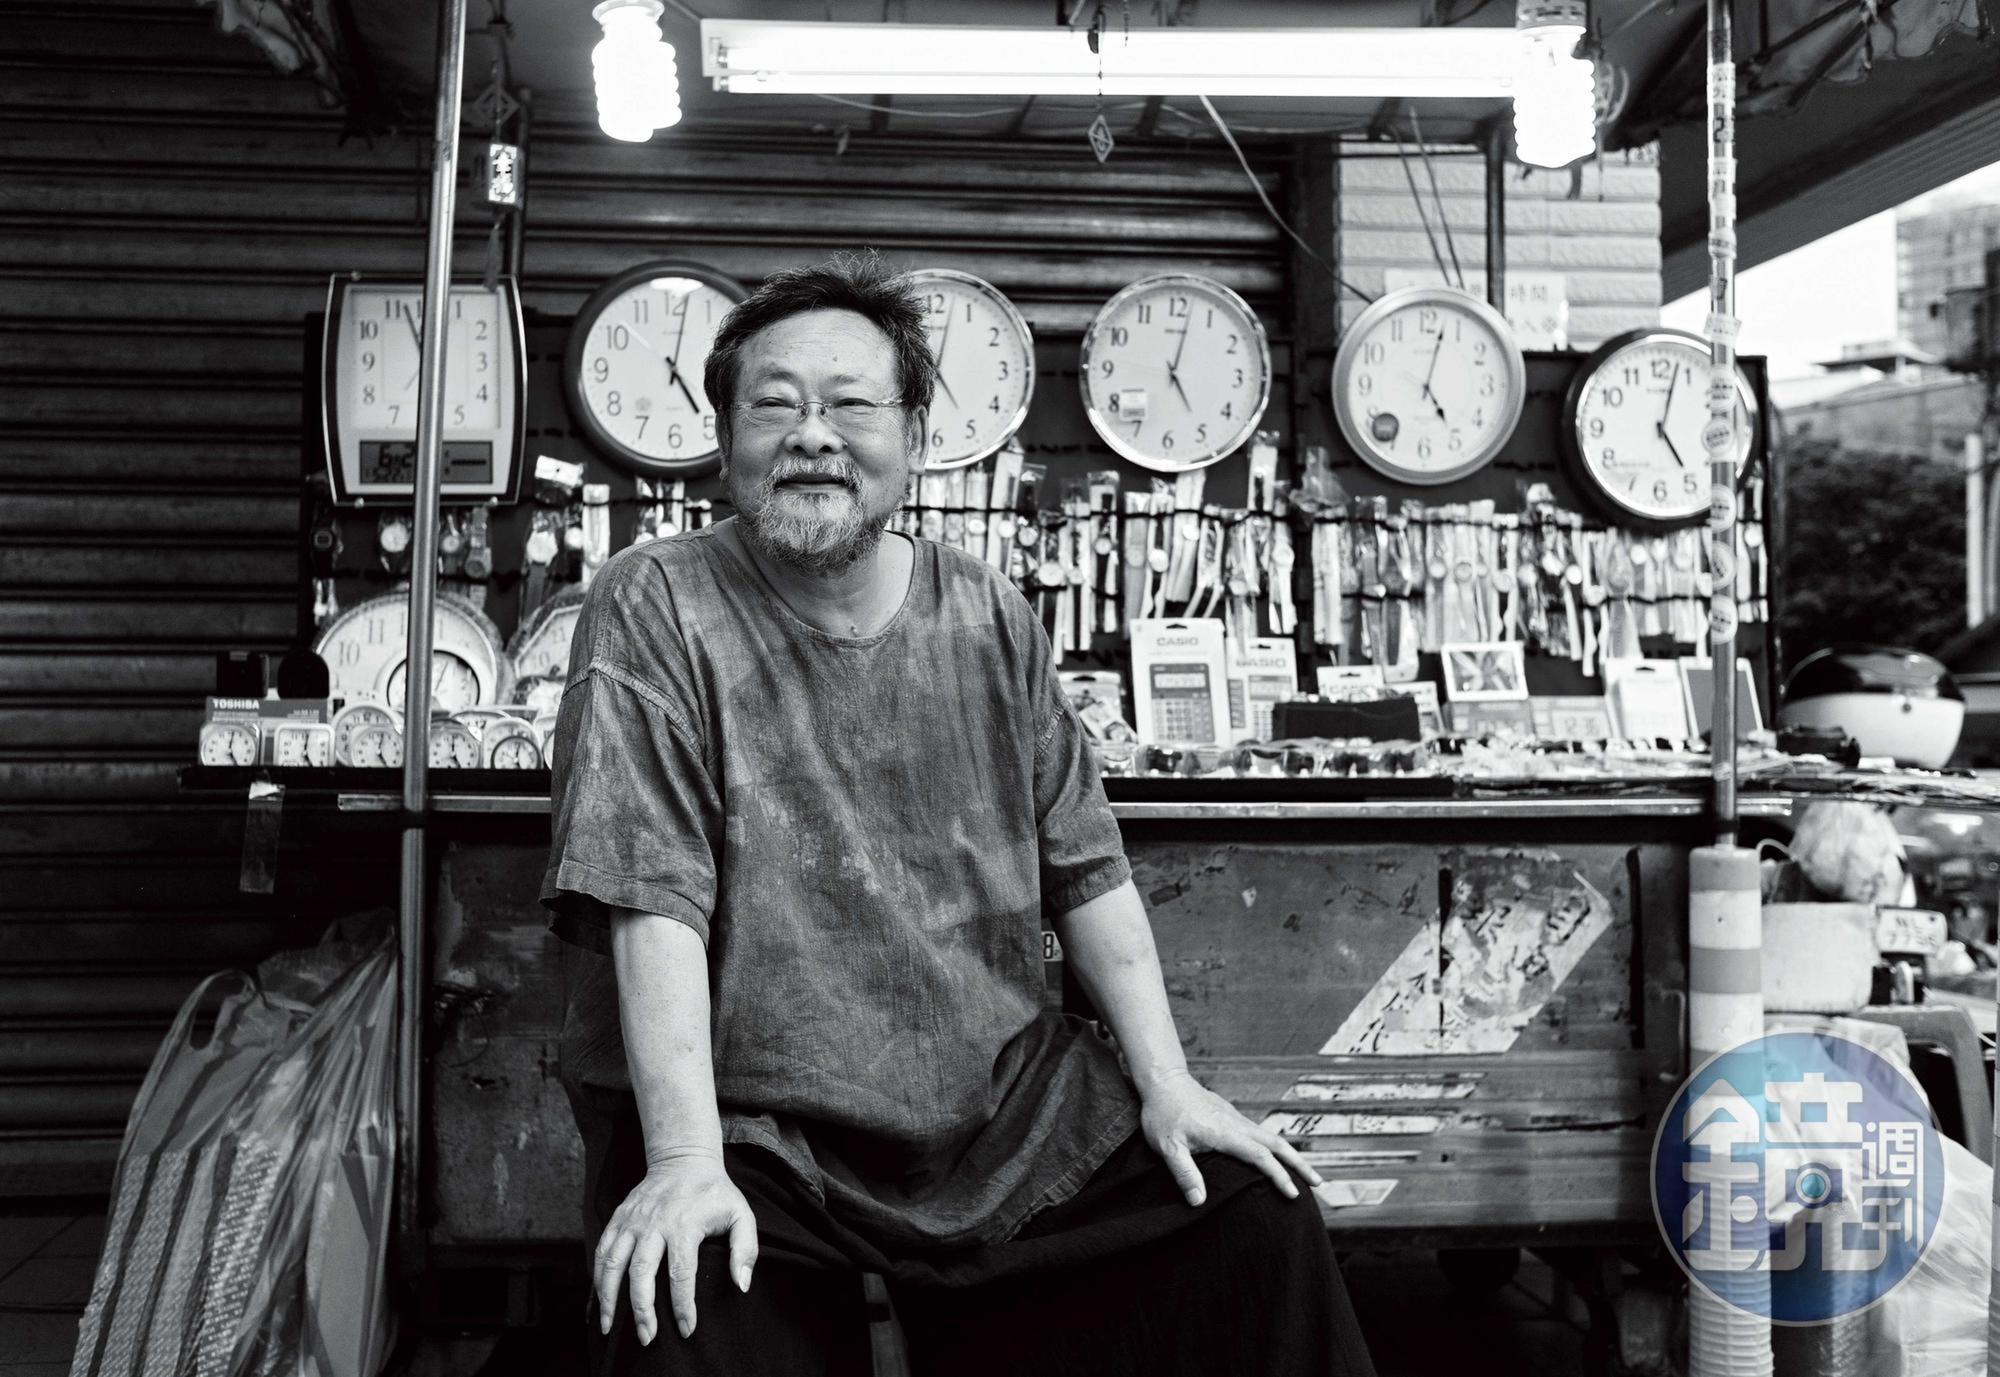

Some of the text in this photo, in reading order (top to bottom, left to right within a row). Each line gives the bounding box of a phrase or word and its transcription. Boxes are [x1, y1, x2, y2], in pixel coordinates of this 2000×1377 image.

[633, 300, 648, 324] 11
[705, 300, 711, 324] 1
[966, 303, 972, 323] 1
[1138, 304, 1151, 324] 11
[1169, 297, 1188, 318] 12
[1206, 309, 1213, 329] 1
[1420, 309, 1437, 334] 12
[359, 320, 378, 340] 10
[475, 321, 488, 341] 2
[607, 325, 629, 351] 10
[989, 327, 999, 347] 2
[1110, 327, 1128, 347] 10
[1391, 318, 1403, 342] 11
[1226, 334, 1238, 354] 2
[1364, 342, 1385, 366] 10
[1474, 342, 1486, 366] 2
[362, 352, 375, 373] 9
[476, 354, 488, 372] 3
[594, 357, 609, 383] 9
[998, 361, 1009, 381] 3
[1102, 360, 1114, 379] 9
[1651, 359, 1670, 379] 12
[1232, 368, 1243, 388] 3
[1358, 374, 1372, 396] 9
[1480, 374, 1494, 397] 3
[1624, 368, 1639, 386] 11
[1685, 368, 1691, 386] 1
[363, 386, 375, 405] 8
[476, 384, 488, 403] 4
[1108, 393, 1120, 413] 8
[1602, 386, 1623, 408] 10
[607, 391, 622, 417] 8
[988, 395, 999, 414] 4
[1220, 401, 1231, 420] 4
[388, 405, 400, 425] 7
[454, 405, 465, 426] 5
[635, 415, 649, 440] 7
[668, 424, 682, 449] 6
[703, 415, 716, 441] 5
[931, 427, 944, 447] 6
[965, 419, 976, 439] 5
[1131, 420, 1142, 438] 7
[1195, 424, 1206, 443] 5
[1590, 419, 1604, 438] 9
[1162, 430, 1174, 449] 6
[1417, 436, 1431, 460] 6
[1449, 428, 1462, 451] 5
[1602, 449, 1615, 469] 8
[1653, 480, 1667, 502] 6
[1683, 474, 1697, 493] 5
[368, 618, 384, 644] 11
[1156, 637, 1199, 647] CASIO
[339, 640, 360, 667] 10
[212, 699, 260, 710] TOSHIBA
